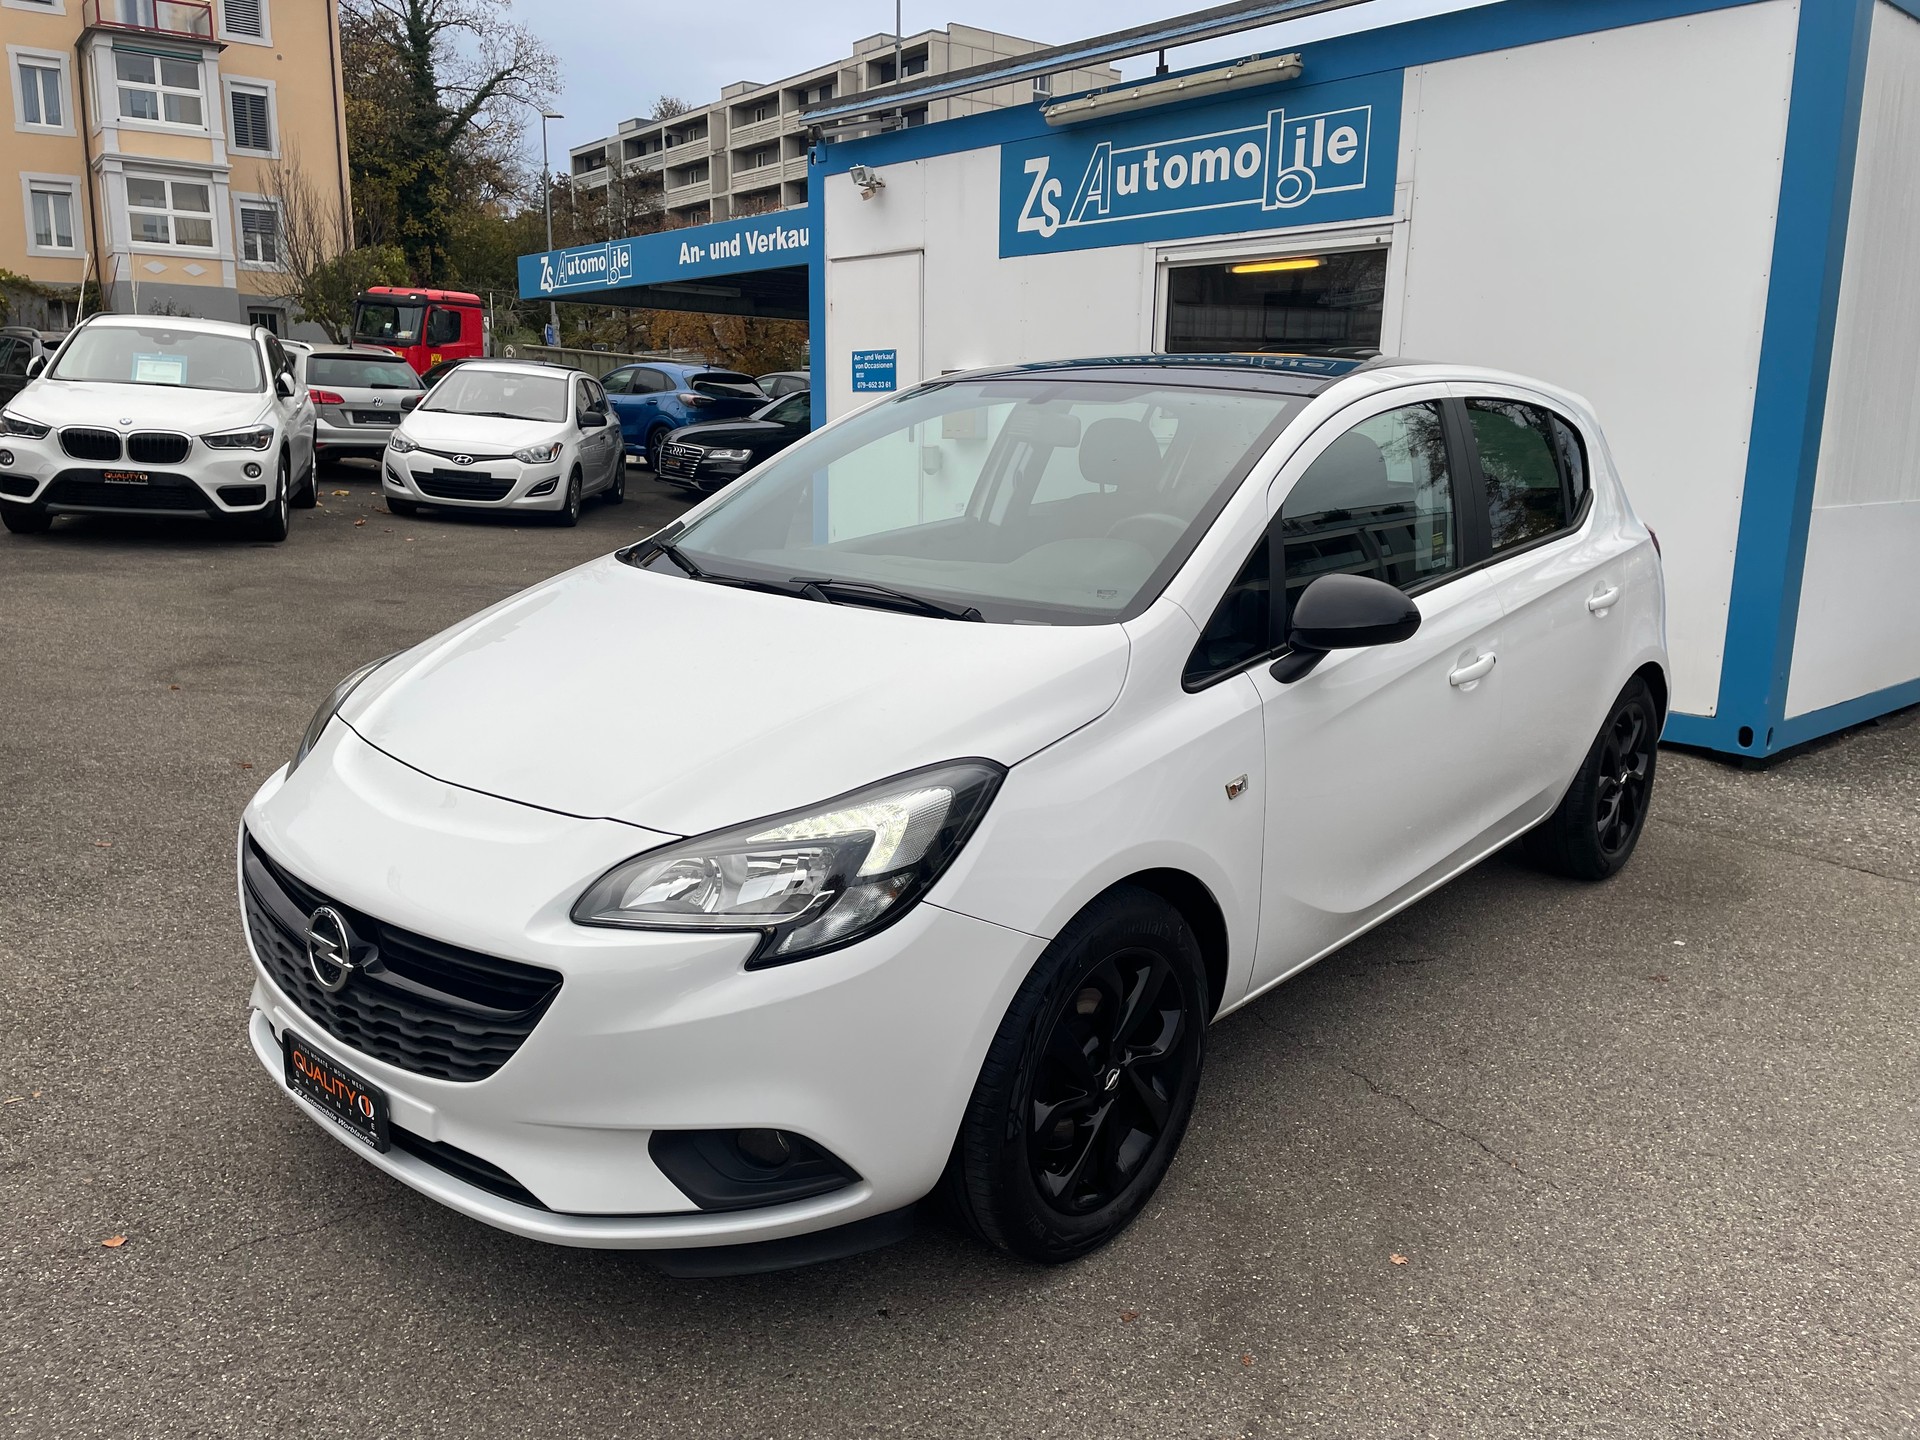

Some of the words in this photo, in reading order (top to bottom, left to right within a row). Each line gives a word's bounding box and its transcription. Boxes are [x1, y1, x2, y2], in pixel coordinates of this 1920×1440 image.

[1066, 107, 1359, 225] Automobile
[556, 243, 629, 287] Automobile
[679, 242, 706, 265] An-
[710, 234, 741, 260] und
[293, 1050, 357, 1107] QUALITY
[302, 1093, 337, 1121] Automobile
[337, 1117, 375, 1147] Worblaufen
